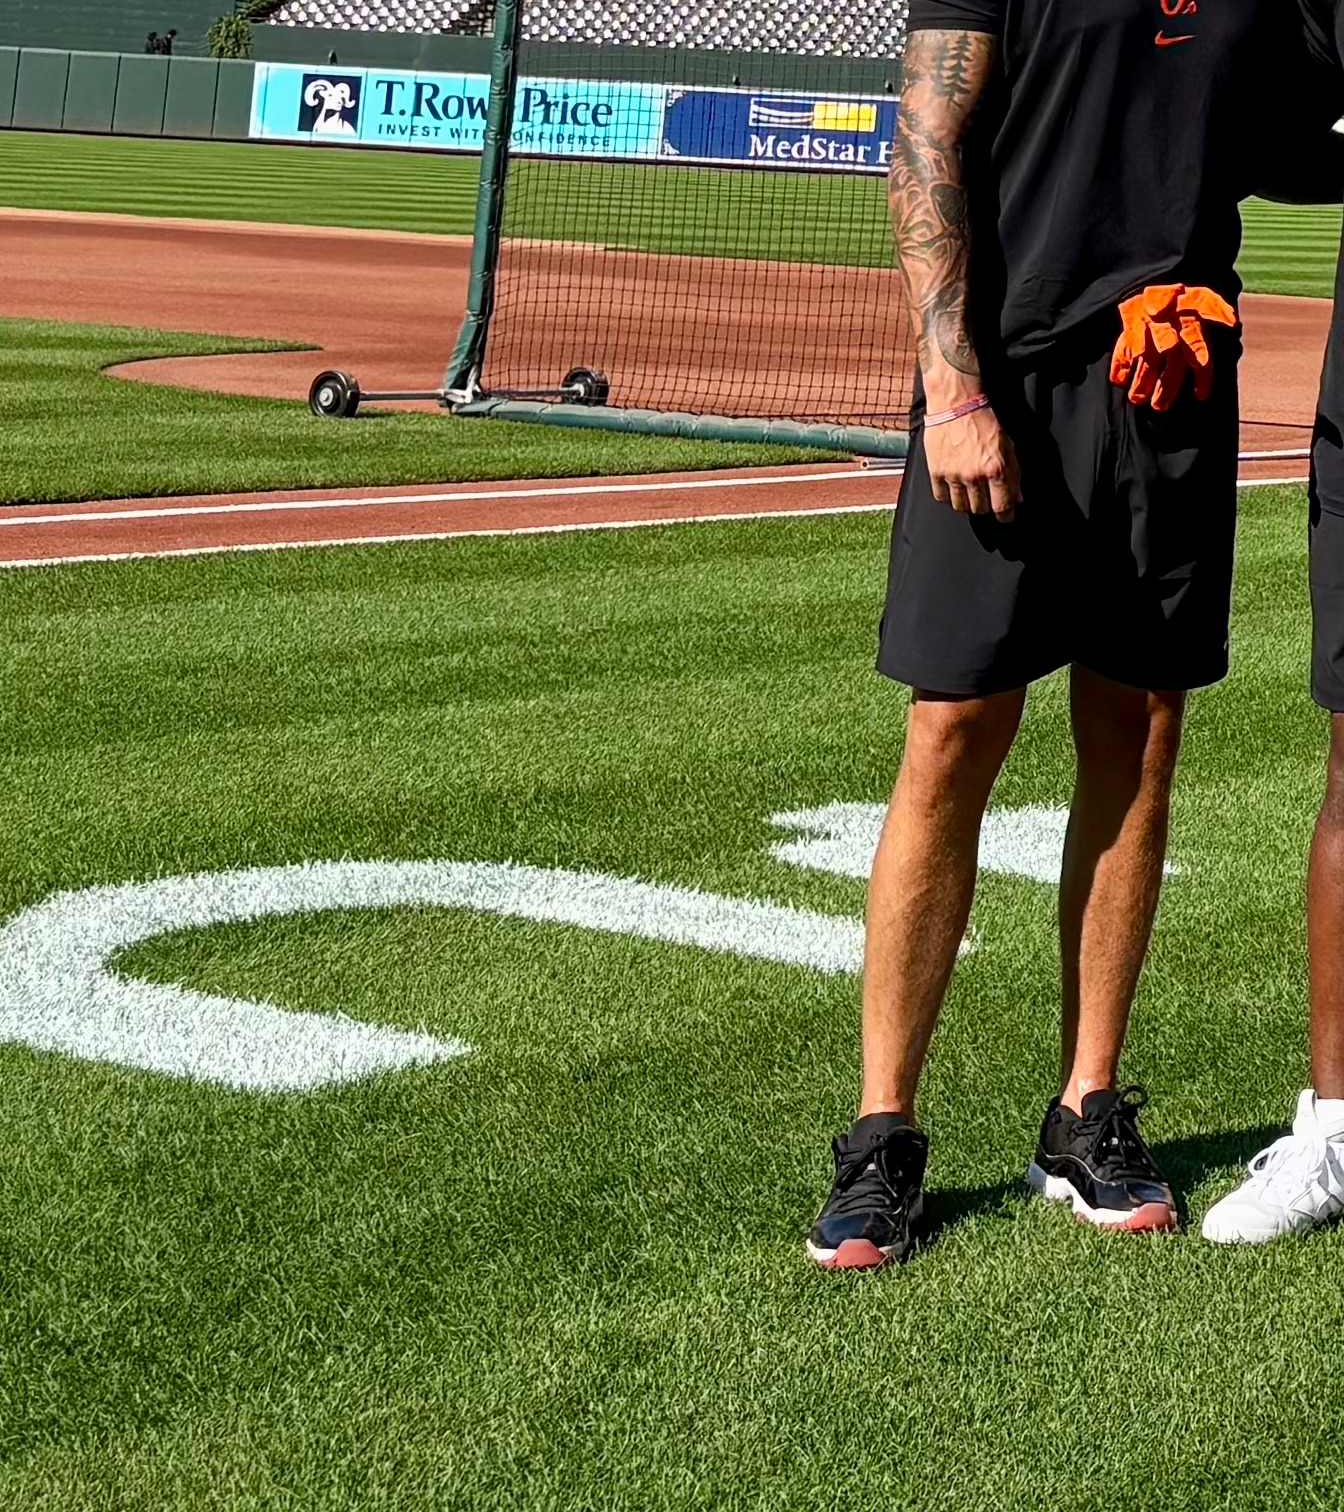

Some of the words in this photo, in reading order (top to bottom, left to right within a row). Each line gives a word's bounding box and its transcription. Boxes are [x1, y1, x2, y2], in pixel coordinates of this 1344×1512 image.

[519, 87, 613, 128] Price
[377, 124, 441, 137] INVEST
[507, 131, 611, 148] ONFIDENCE
[749, 134, 871, 163] MedStar
